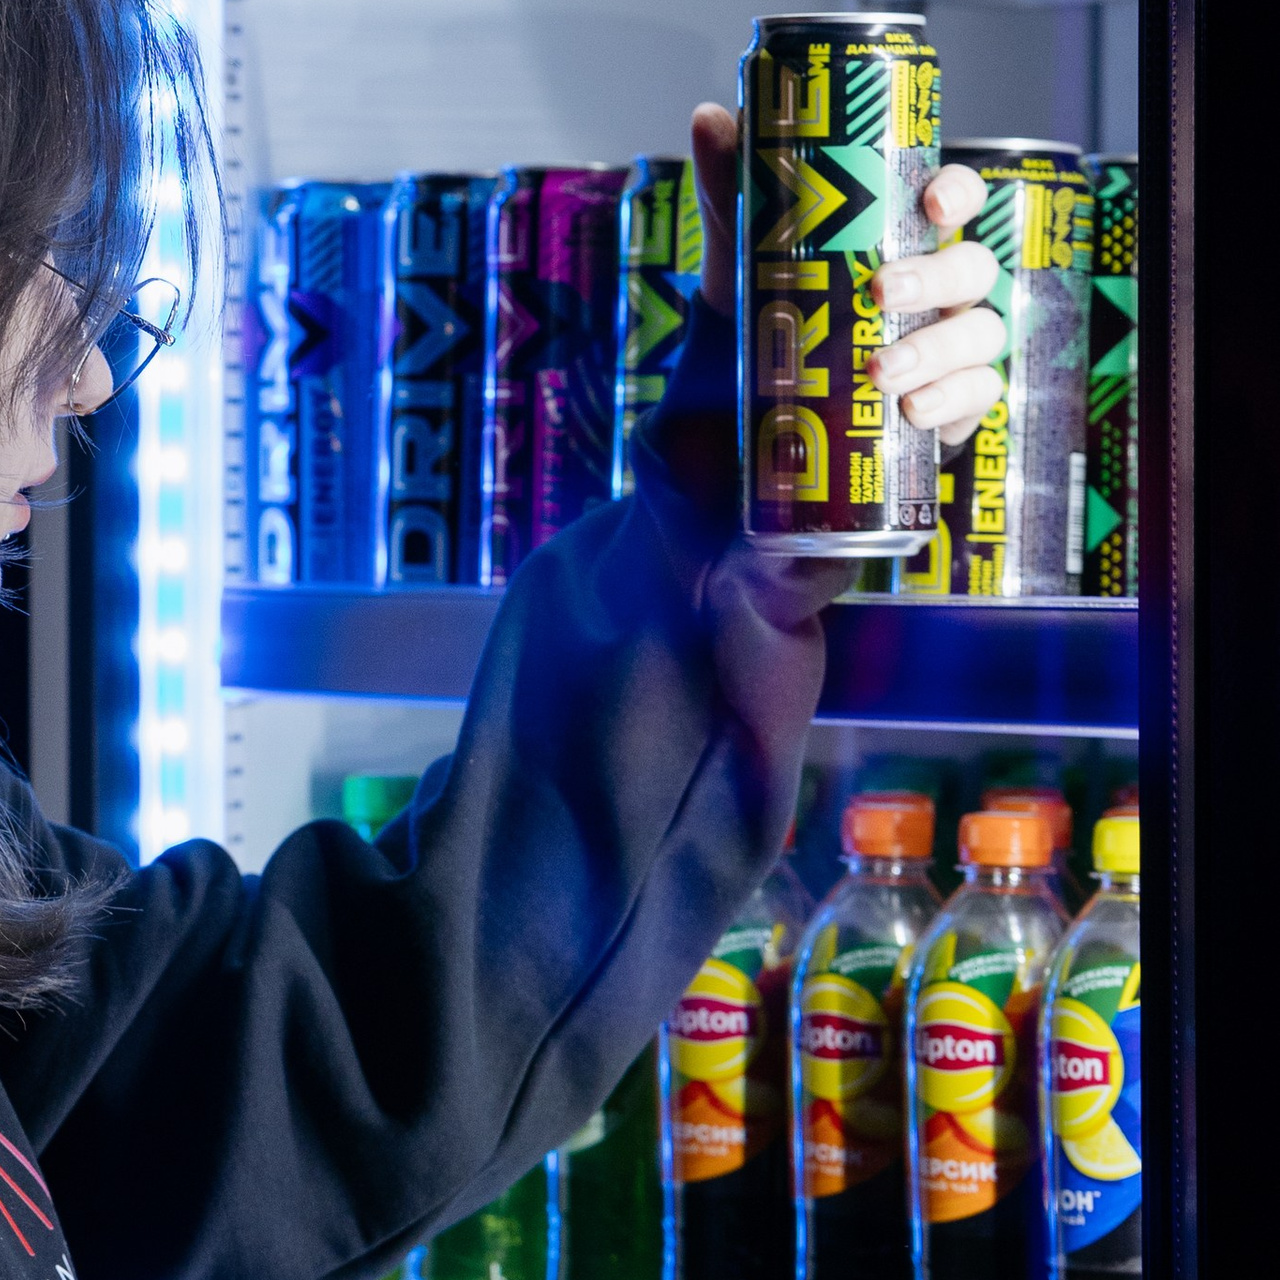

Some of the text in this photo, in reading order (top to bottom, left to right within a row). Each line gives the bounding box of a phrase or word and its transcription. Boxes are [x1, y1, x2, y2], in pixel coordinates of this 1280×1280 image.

[390, 208, 472, 583] DRIVE
[757, 50, 848, 503] DRIVE
[972, 400, 1010, 533] ENERG
